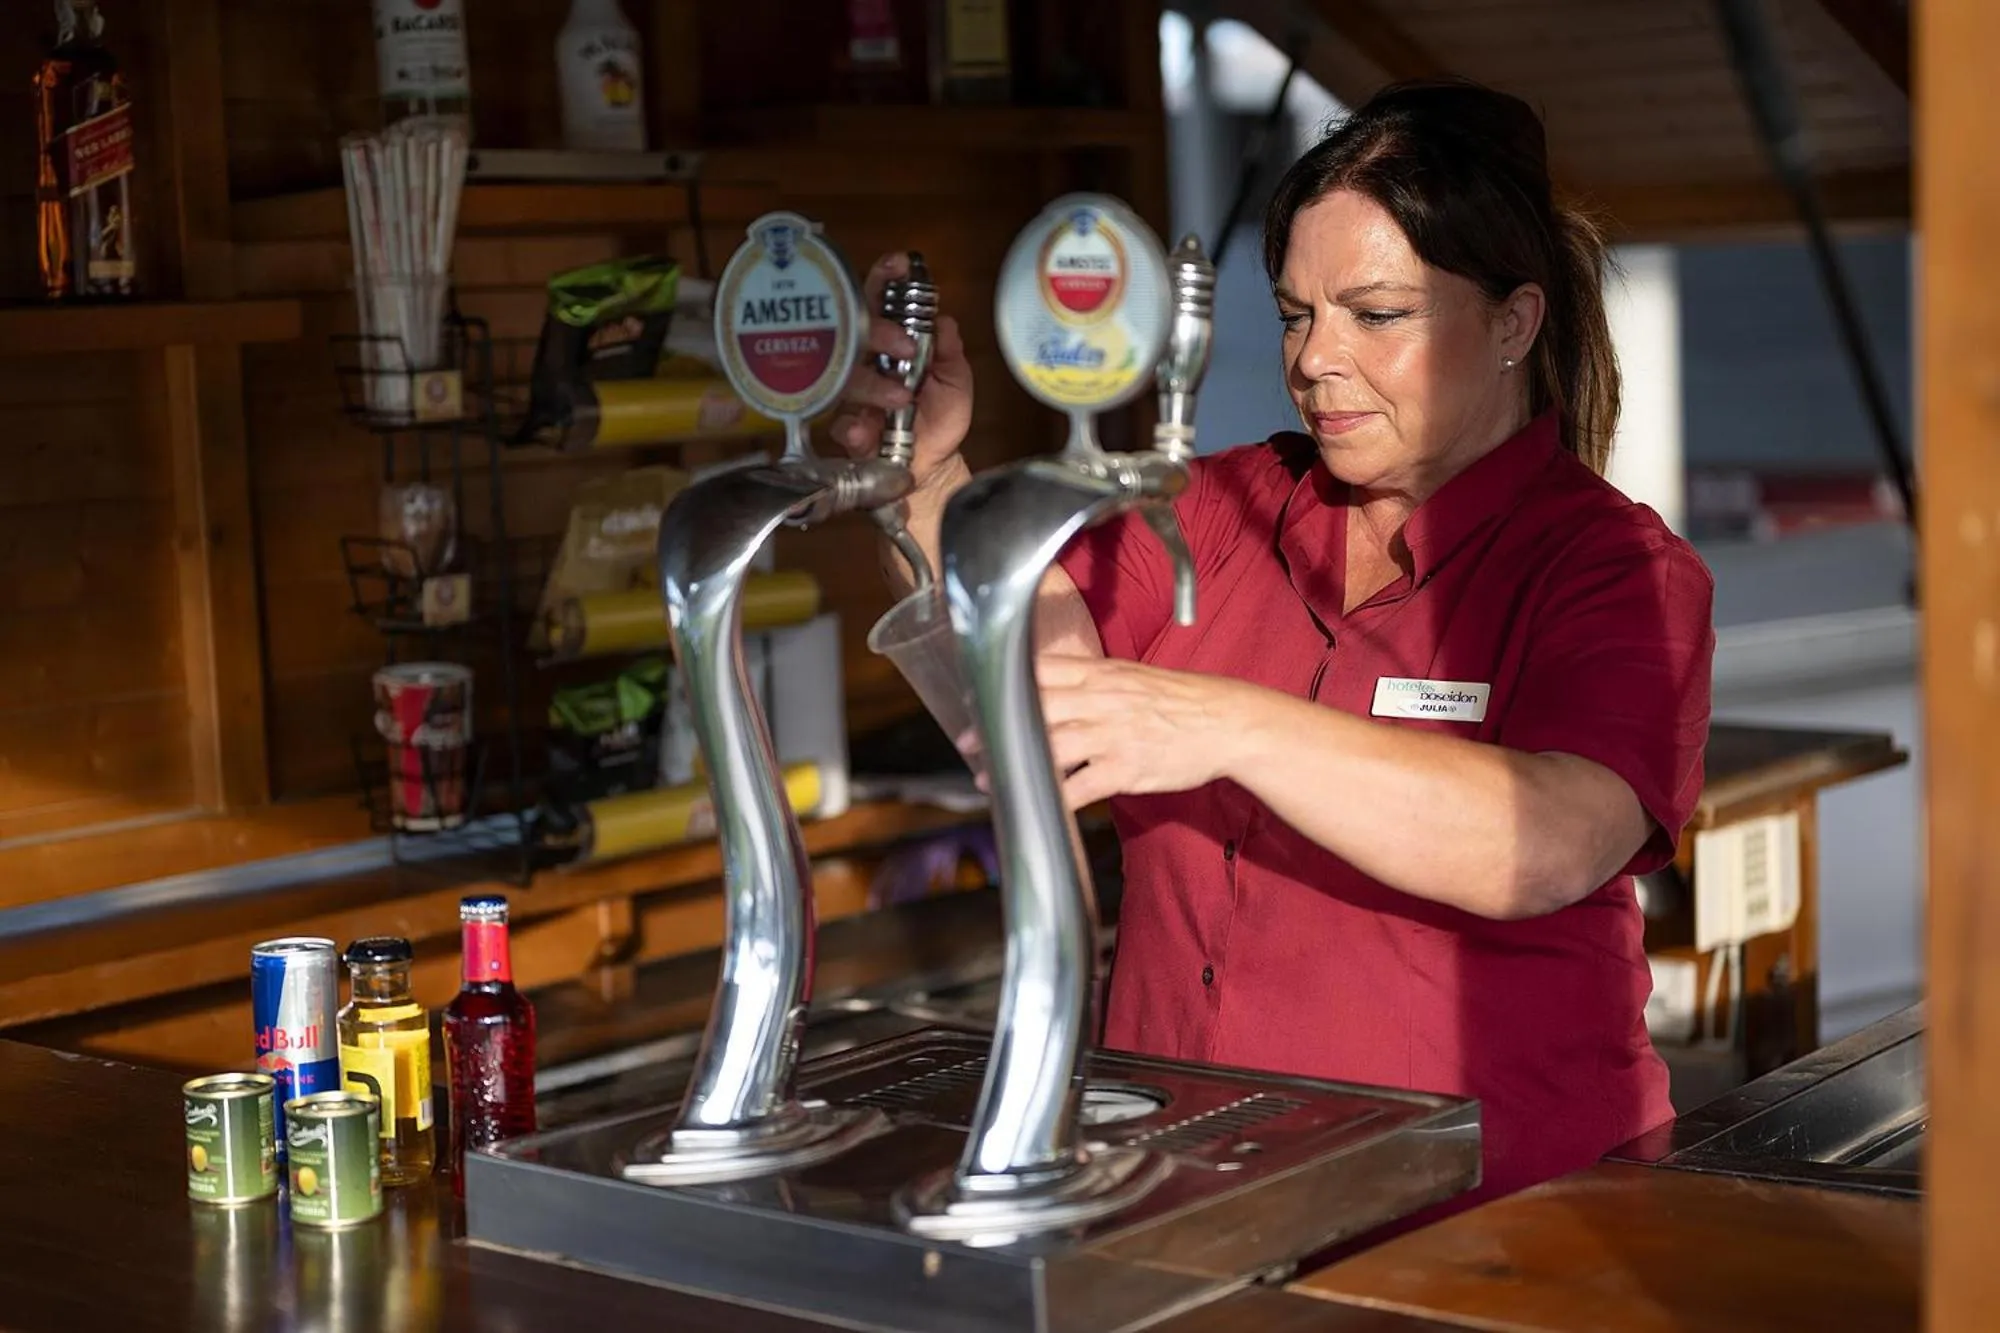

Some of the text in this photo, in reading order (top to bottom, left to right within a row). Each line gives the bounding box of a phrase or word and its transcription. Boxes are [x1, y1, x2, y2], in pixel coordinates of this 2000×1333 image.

[1056, 254, 1111, 269] AMSTEL
[741, 294, 831, 325] AMSTEL
[753, 336, 820, 356] CERVEZA
[1420, 704, 1448, 712] JULIA
[273, 1023, 320, 1050] Bull
[278, 1074, 315, 1085] DRNK
